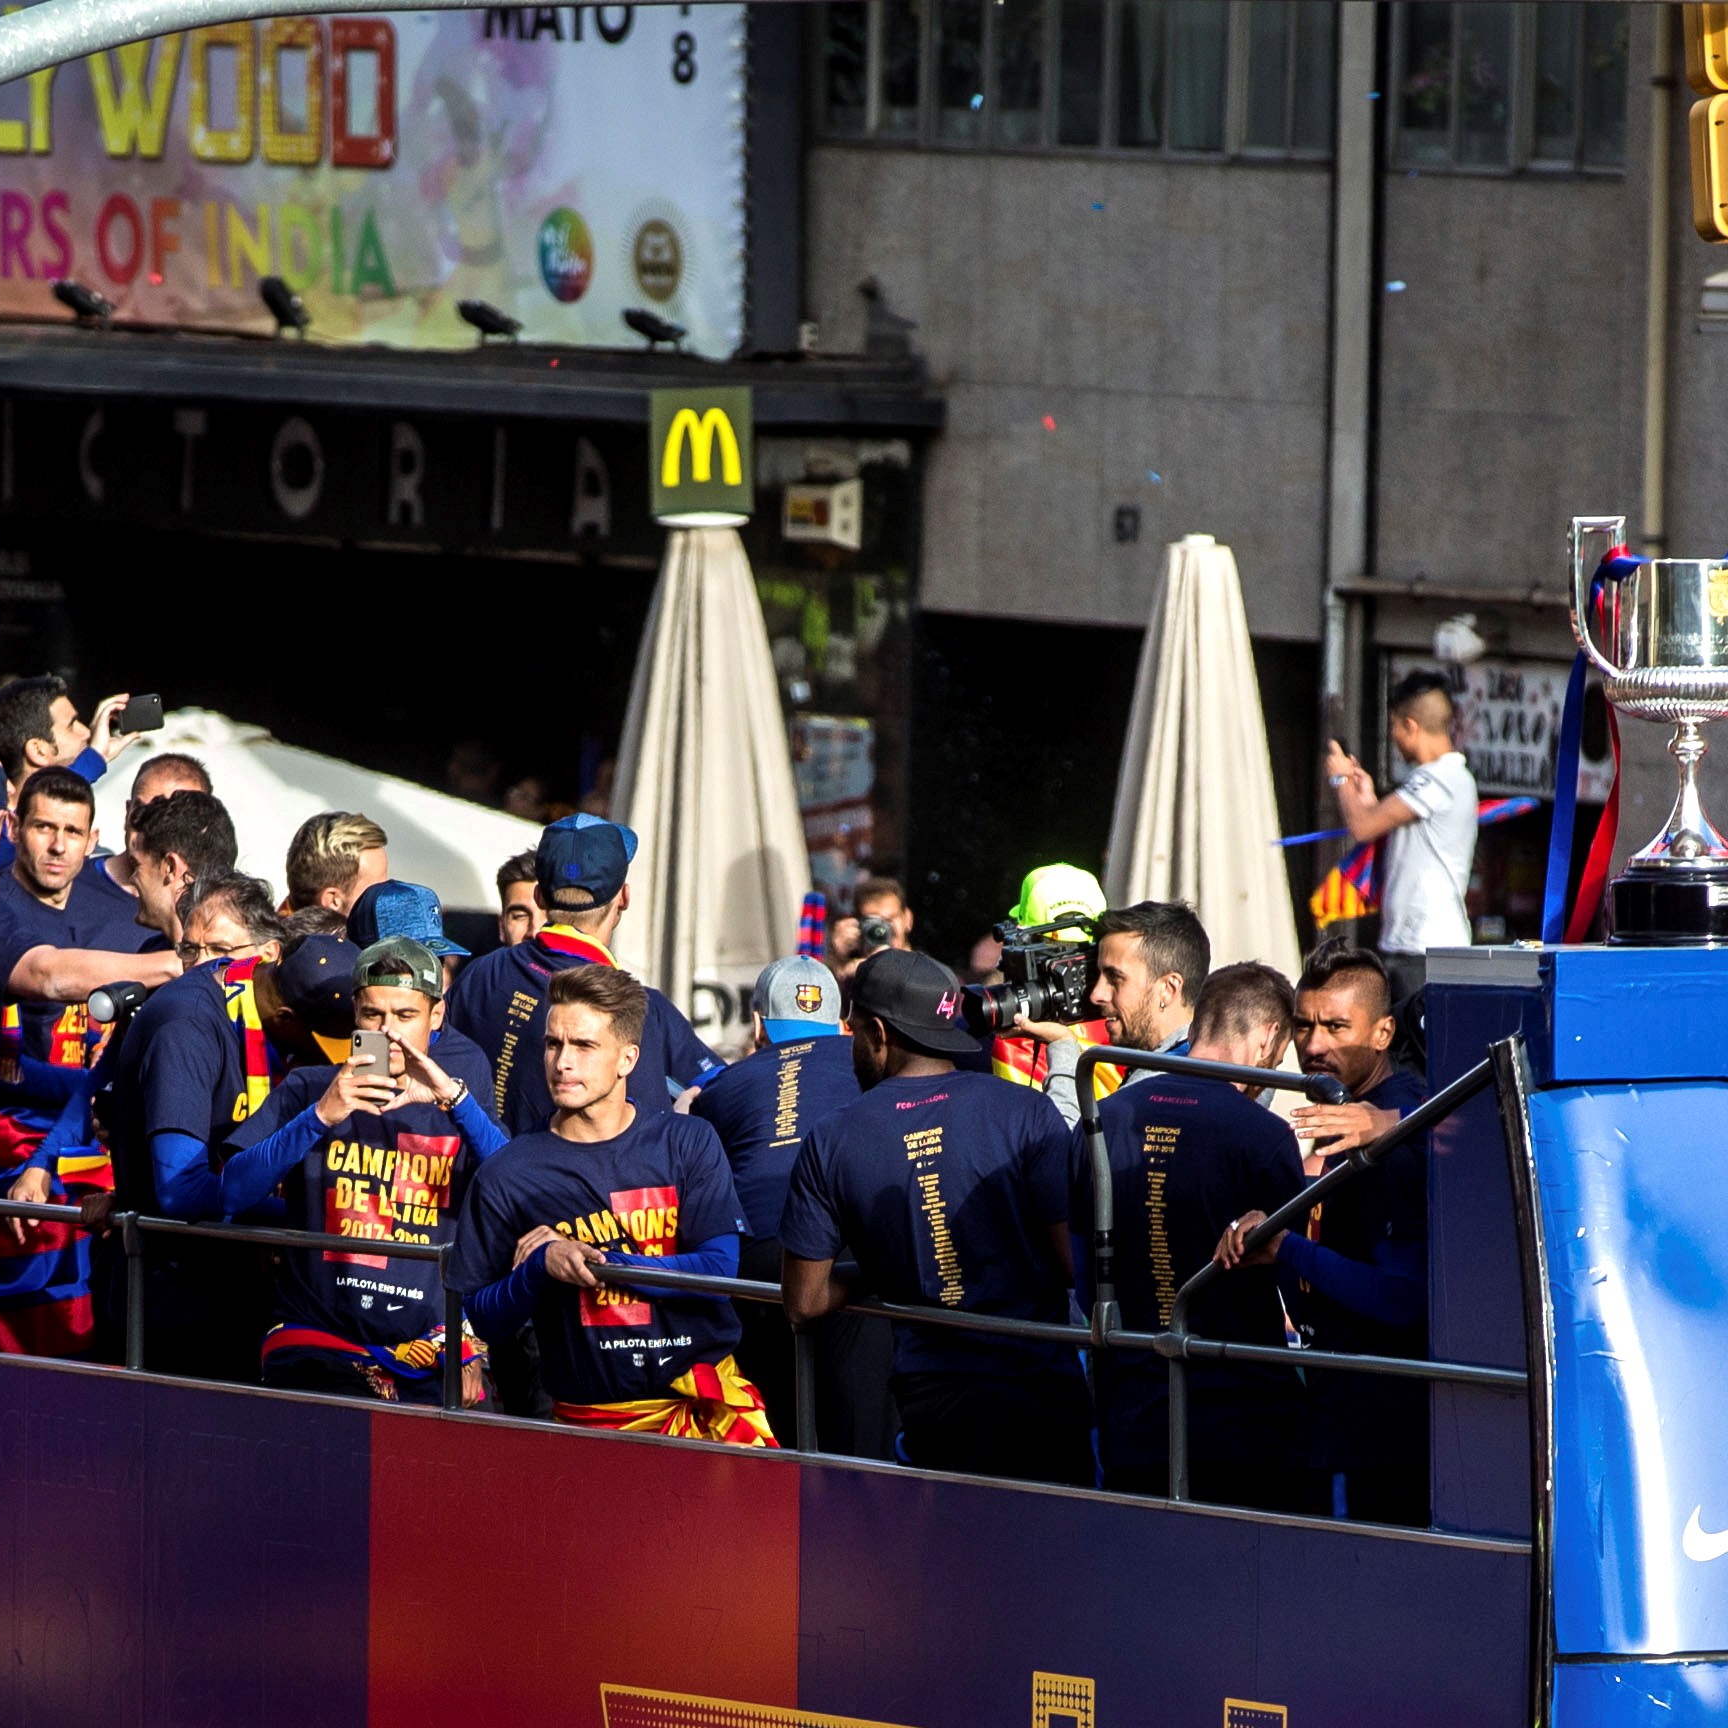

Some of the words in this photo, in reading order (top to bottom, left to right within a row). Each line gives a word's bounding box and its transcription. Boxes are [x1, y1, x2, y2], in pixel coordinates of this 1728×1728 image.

[673, 30, 697, 84] 8
[95, 193, 181, 286] OF
[207, 201, 397, 298] INDIA
[903, 1126, 944, 1143] CAMPIONS
[1144, 1125, 1182, 1136] CAMPIONS
[326, 1139, 454, 1188] CAMPIONS
[335, 1176, 370, 1213] DE
[378, 1183, 439, 1228] LLIGA
[555, 1205, 679, 1244] CAMIONS
[613, 1338, 646, 1350] PILOTA
